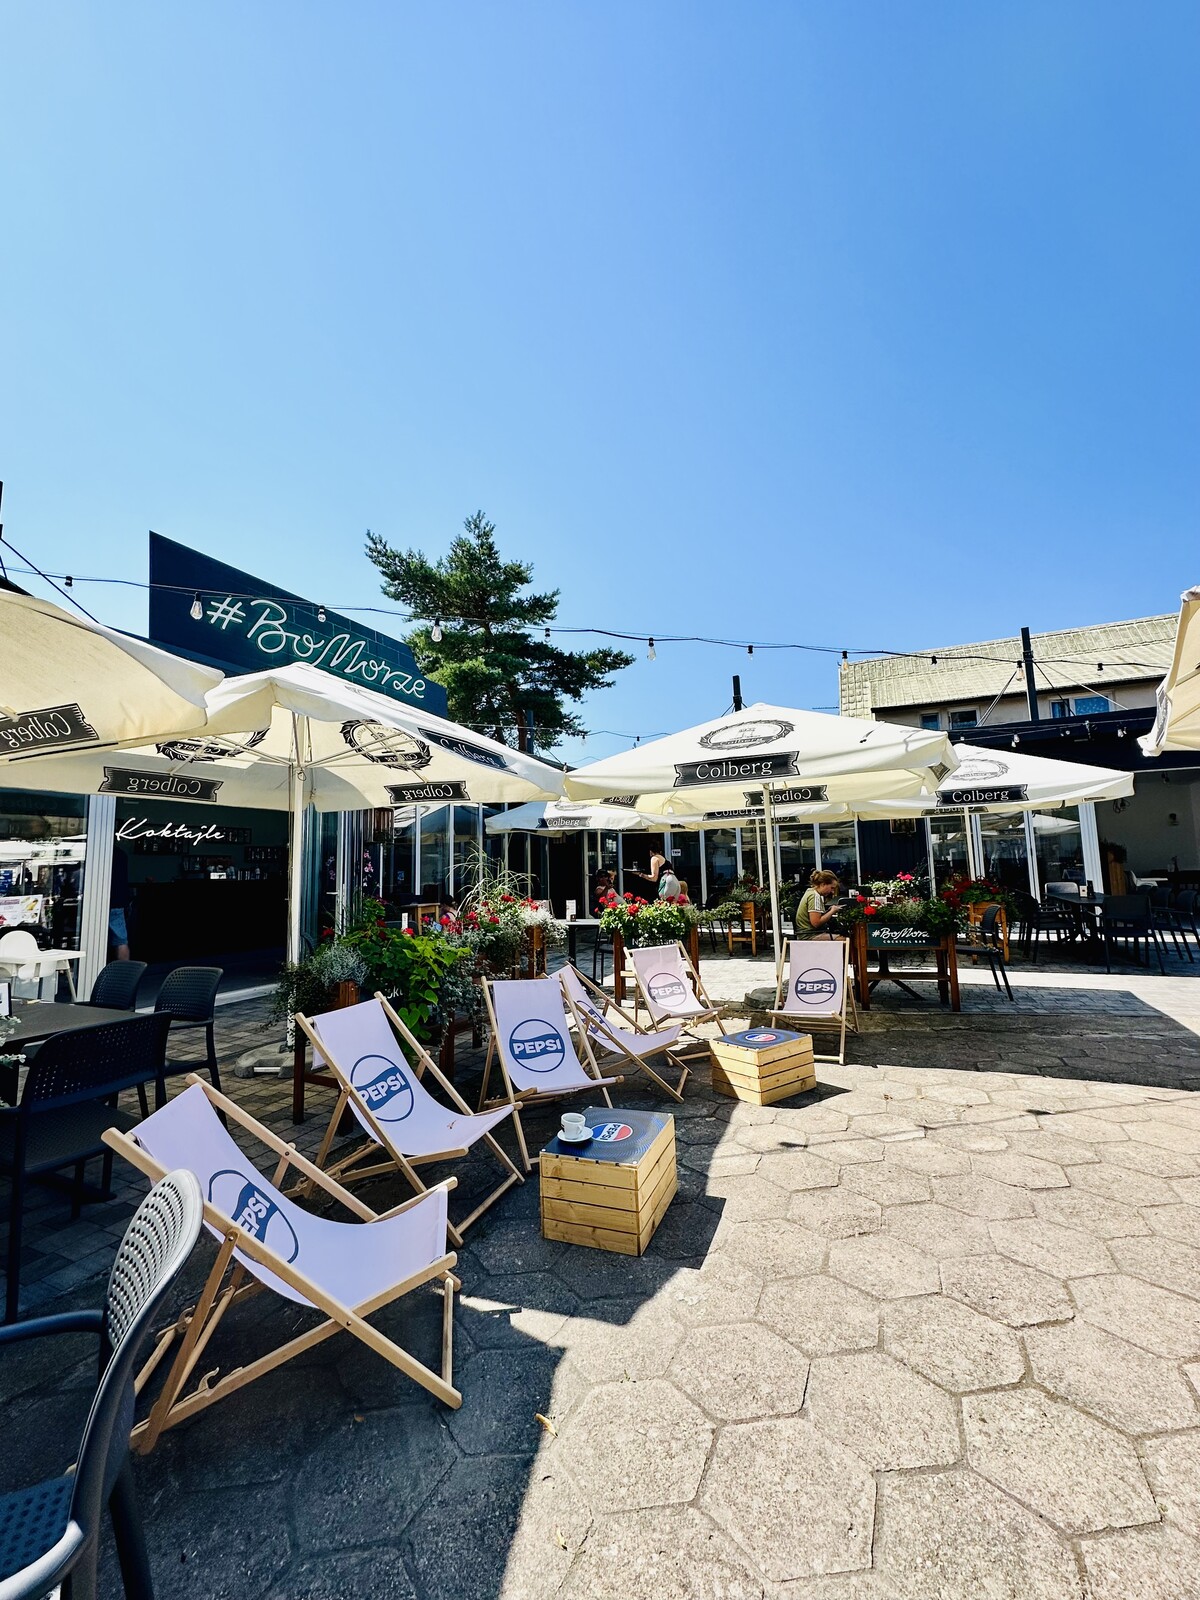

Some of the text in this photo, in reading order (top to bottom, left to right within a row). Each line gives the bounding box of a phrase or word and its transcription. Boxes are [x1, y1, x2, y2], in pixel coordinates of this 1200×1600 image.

[206, 597, 426, 698] #BoMorze
[695, 760, 773, 780] Colberg
[952, 790, 1009, 803] Colberg
[115, 817, 225, 846] Koktajle
[547, 818, 580, 827] Colberg
[650, 985, 685, 997] PEPSI
[798, 982, 835, 992] PEPSI
[512, 1038, 562, 1055] PEPSI
[357, 1072, 406, 1103] PEPSI
[236, 1190, 270, 1237] EPSI
